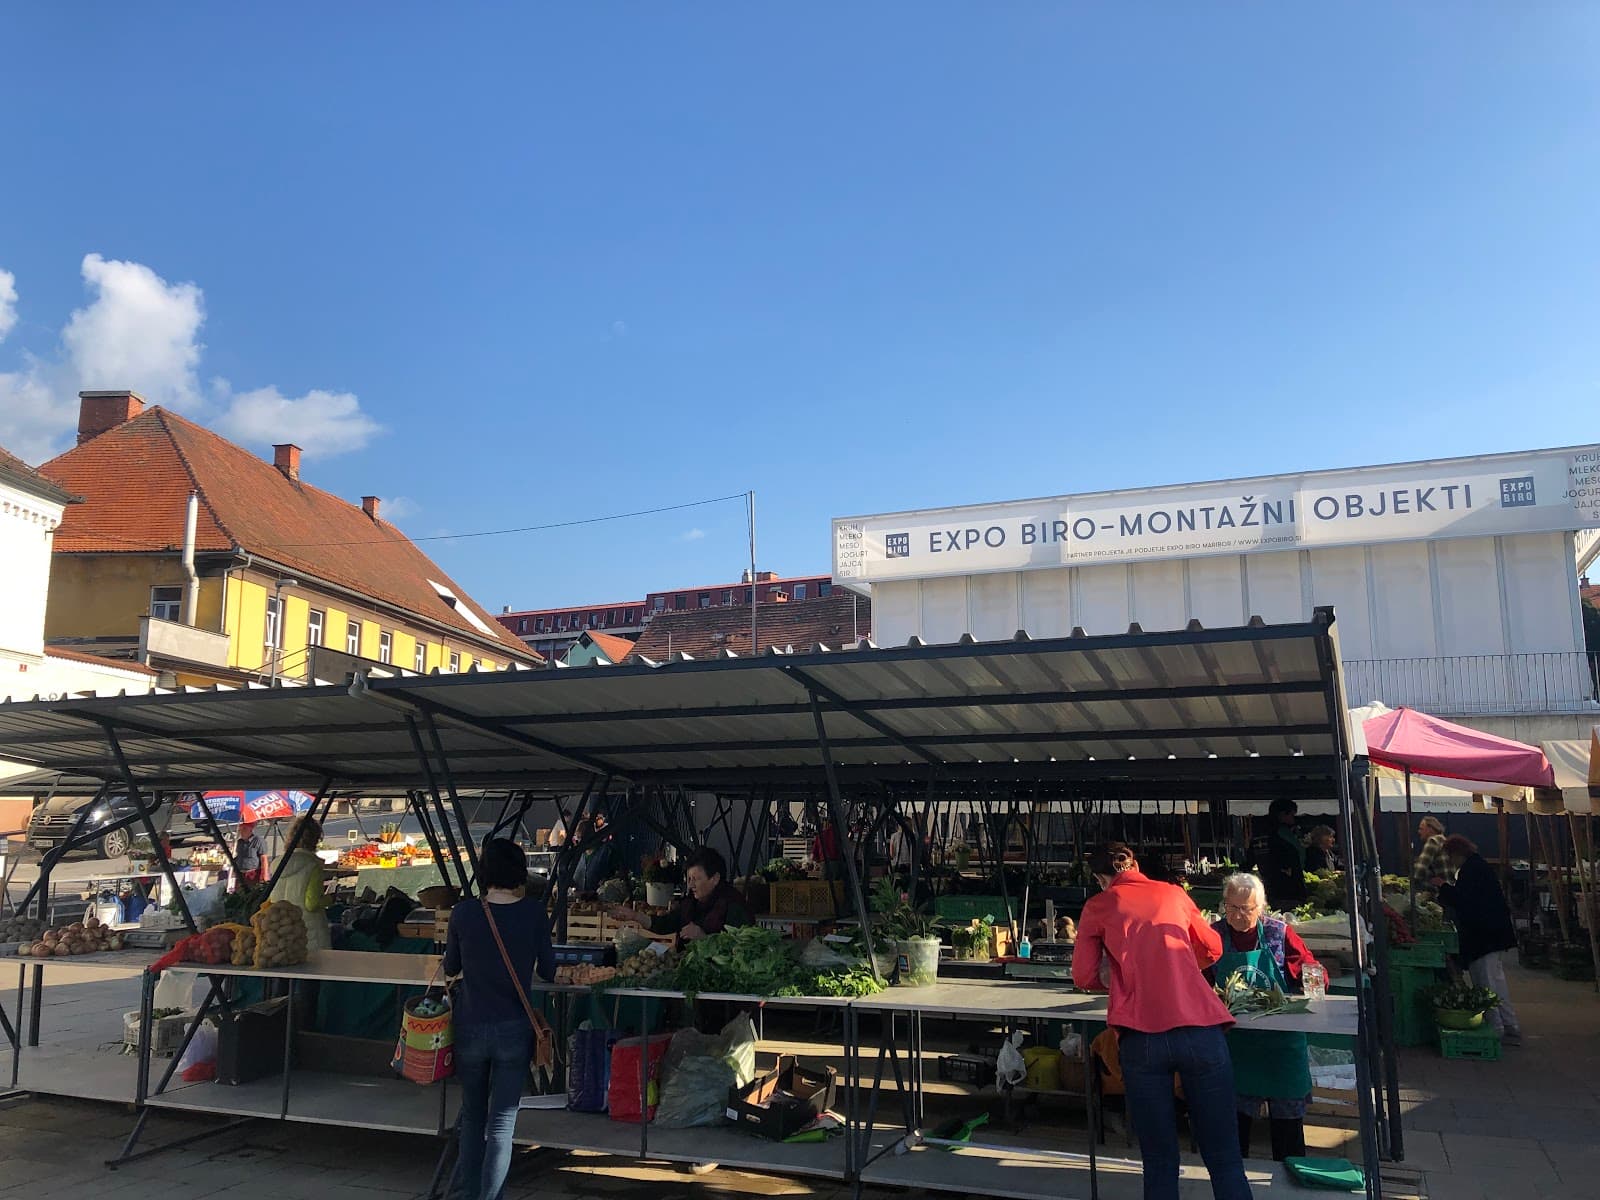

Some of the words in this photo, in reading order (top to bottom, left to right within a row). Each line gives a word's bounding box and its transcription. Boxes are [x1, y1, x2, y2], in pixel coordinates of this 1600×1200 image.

[1502, 481, 1532, 493] EXPO
[1503, 492, 1533, 503] BIRO
[1562, 488, 1600, 499] JOGUR
[1573, 500, 1600, 509] JAJC
[929, 526, 1006, 553] EXPO
[1021, 496, 1296, 545] BIRO-MONTAŽNI
[1313, 484, 1472, 521] OBJEKTI
[887, 536, 908, 546] EXPO
[250, 791, 281, 810] LIQUI
[255, 799, 285, 817] MOLY
